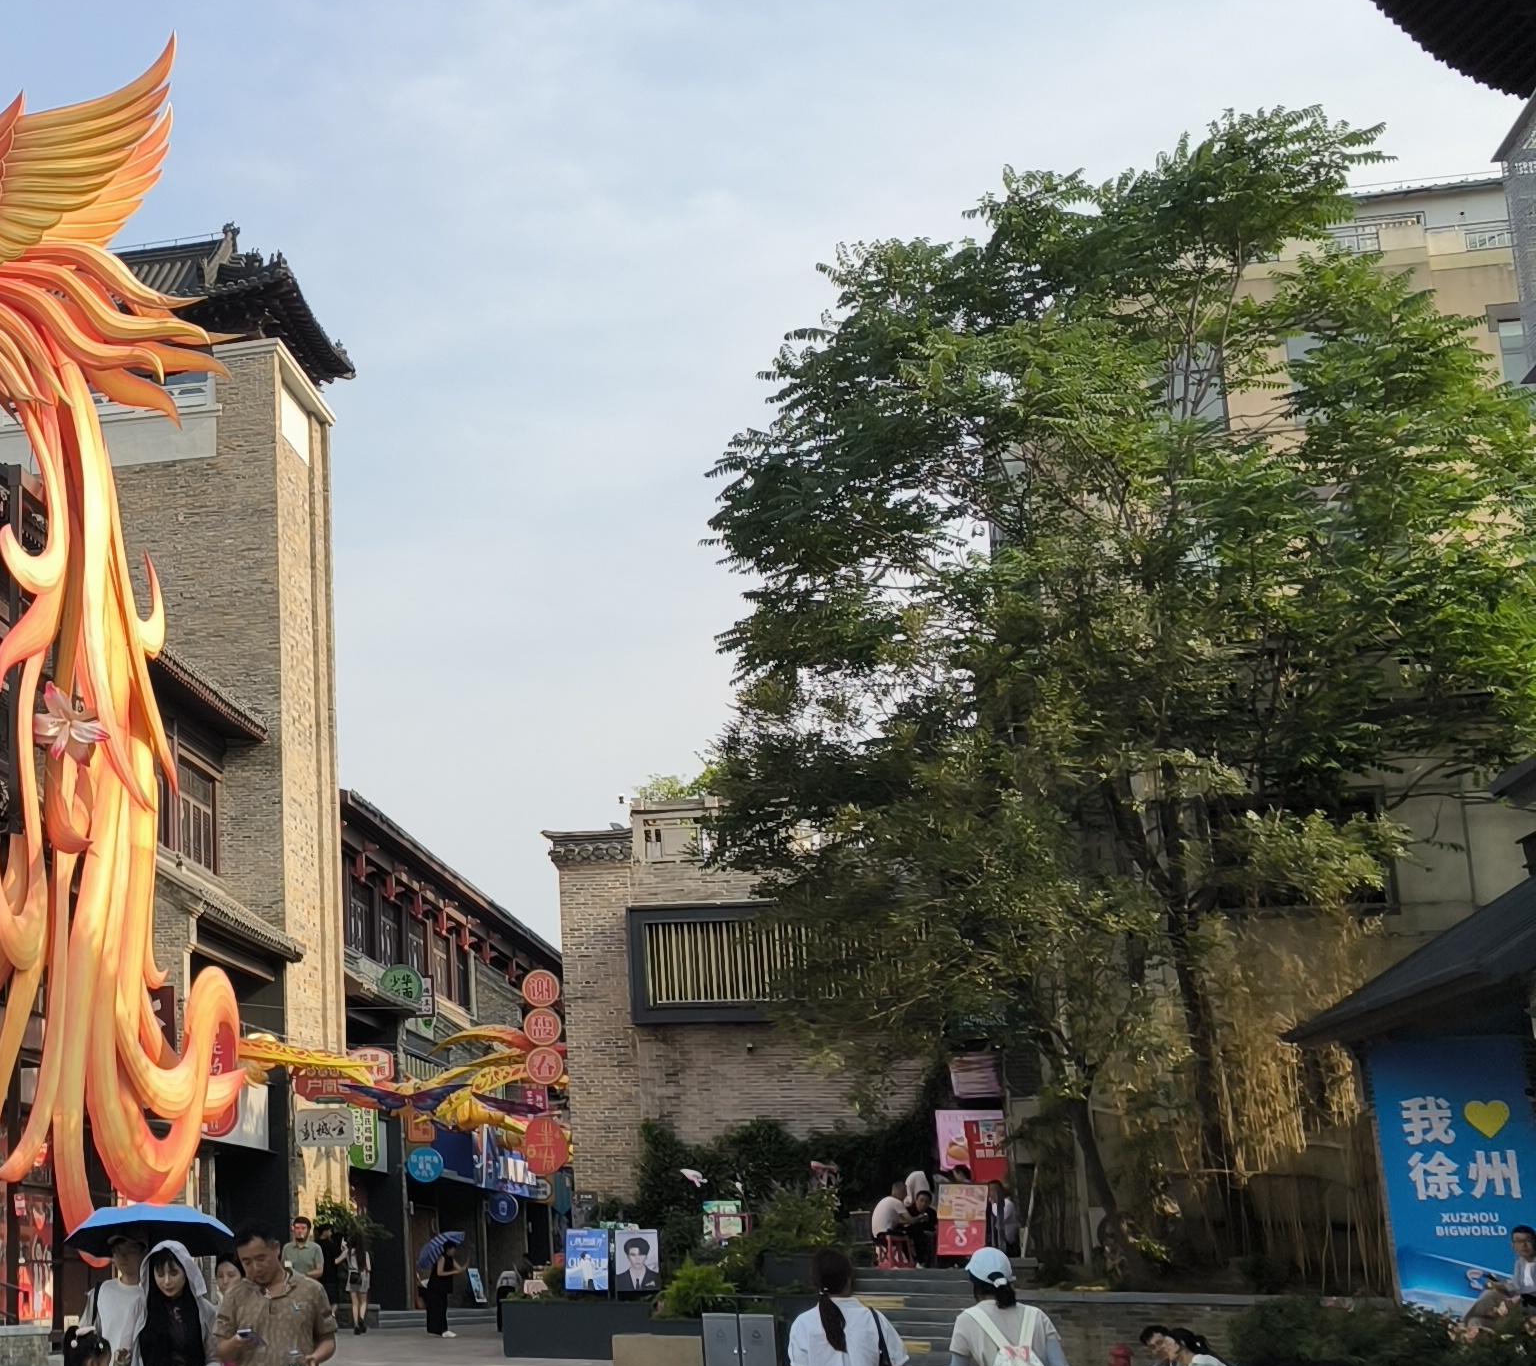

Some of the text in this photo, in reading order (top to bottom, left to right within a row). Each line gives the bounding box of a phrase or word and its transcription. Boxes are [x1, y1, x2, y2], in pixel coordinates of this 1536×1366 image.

[1399, 1096, 1457, 1146] 我
[1407, 1149, 1522, 1202] 徐州
[1435, 1225, 1508, 1237] BIGWORLD
[1440, 1212, 1500, 1224] XUZHOU
